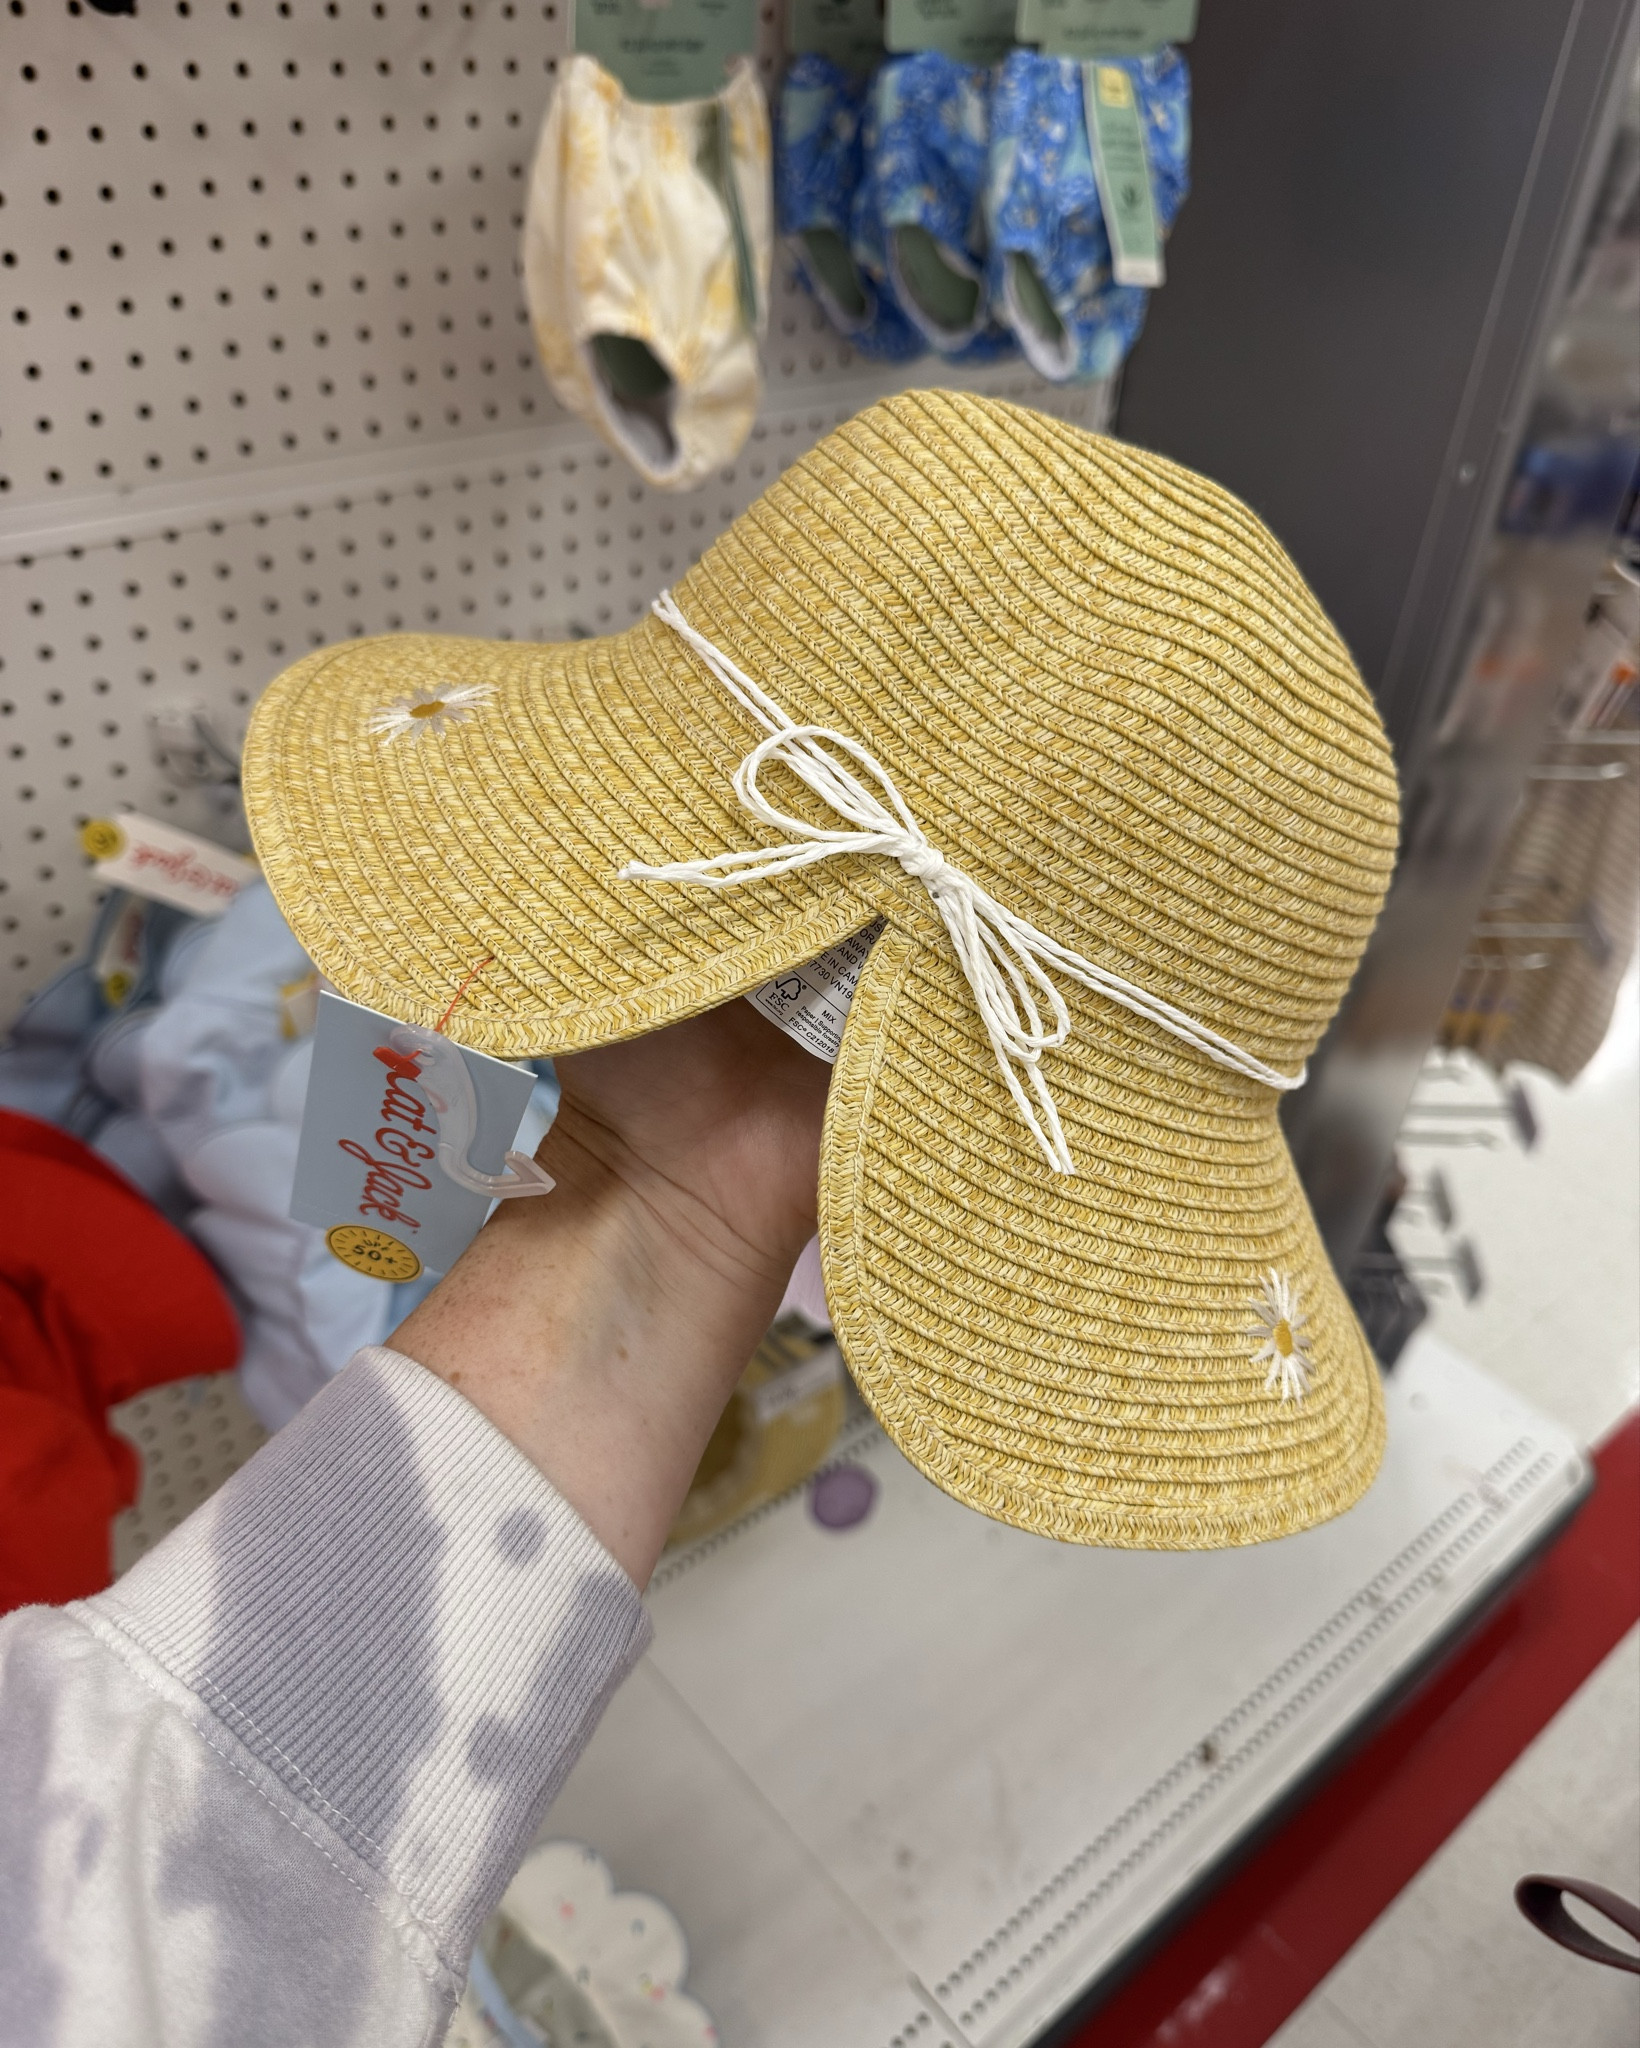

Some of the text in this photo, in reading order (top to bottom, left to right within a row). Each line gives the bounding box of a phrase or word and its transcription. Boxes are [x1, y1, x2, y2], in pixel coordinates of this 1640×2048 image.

[837, 946, 858, 965] AND
[808, 960, 853, 1001] 7730 VN19
[827, 957, 839, 969] IN
[837, 966, 859, 987] CAM
[769, 992, 790, 1011] FSC
[800, 1005, 817, 1020] Paper
[796, 1010, 823, 1034] responsible
[821, 1010, 837, 1024] MIX
[806, 1032, 835, 1054] C212018
[375, 1127, 435, 1167] &
[338, 1138, 432, 1228] Jack
[352, 1243, 398, 1264] 50+
